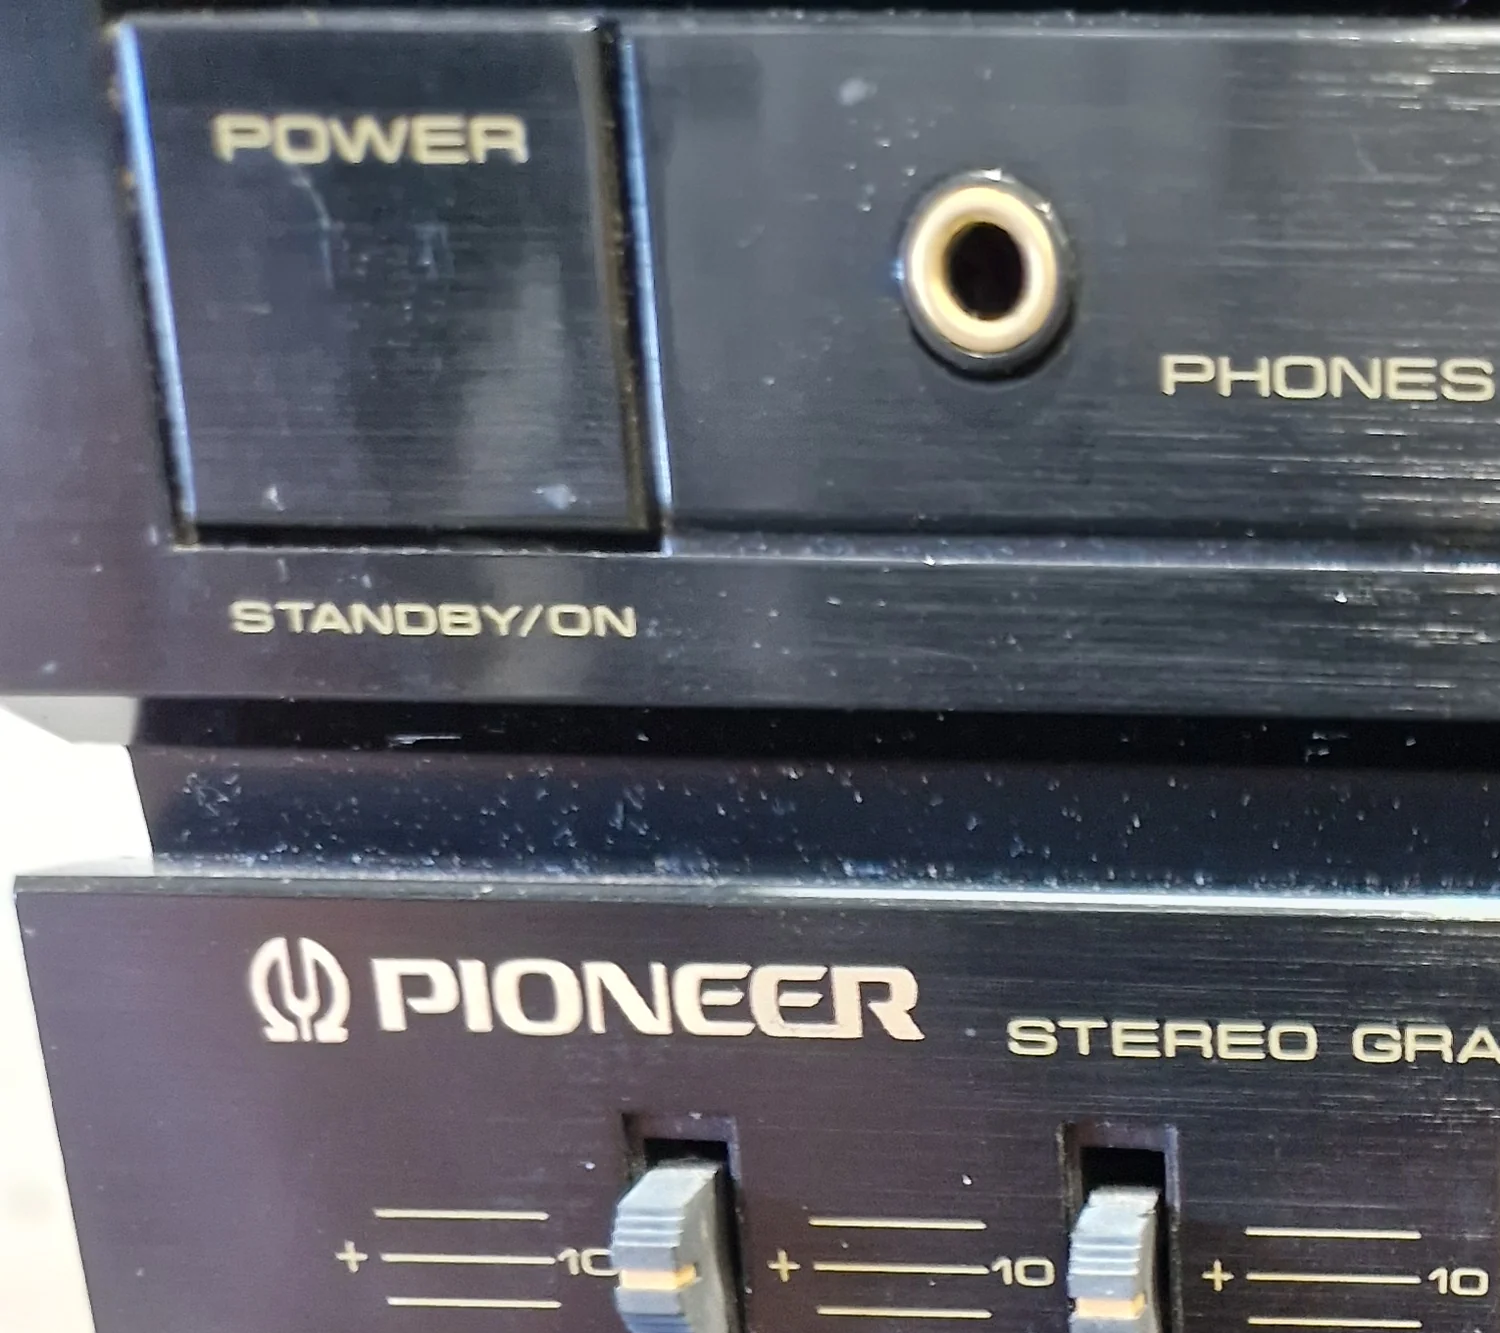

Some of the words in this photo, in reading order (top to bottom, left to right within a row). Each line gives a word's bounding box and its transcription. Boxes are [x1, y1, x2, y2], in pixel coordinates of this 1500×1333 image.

[213, 113, 529, 166] POWER
[1161, 353, 1496, 402] PHONES
[229, 599, 637, 638] STANDBY/ON
[370, 957, 925, 1040] PIONEER
[1006, 1017, 1318, 1061] STEREO
[557, 1247, 619, 1277] 10
[991, 1256, 1055, 1287] 10
[1428, 1267, 1489, 1296] 10
